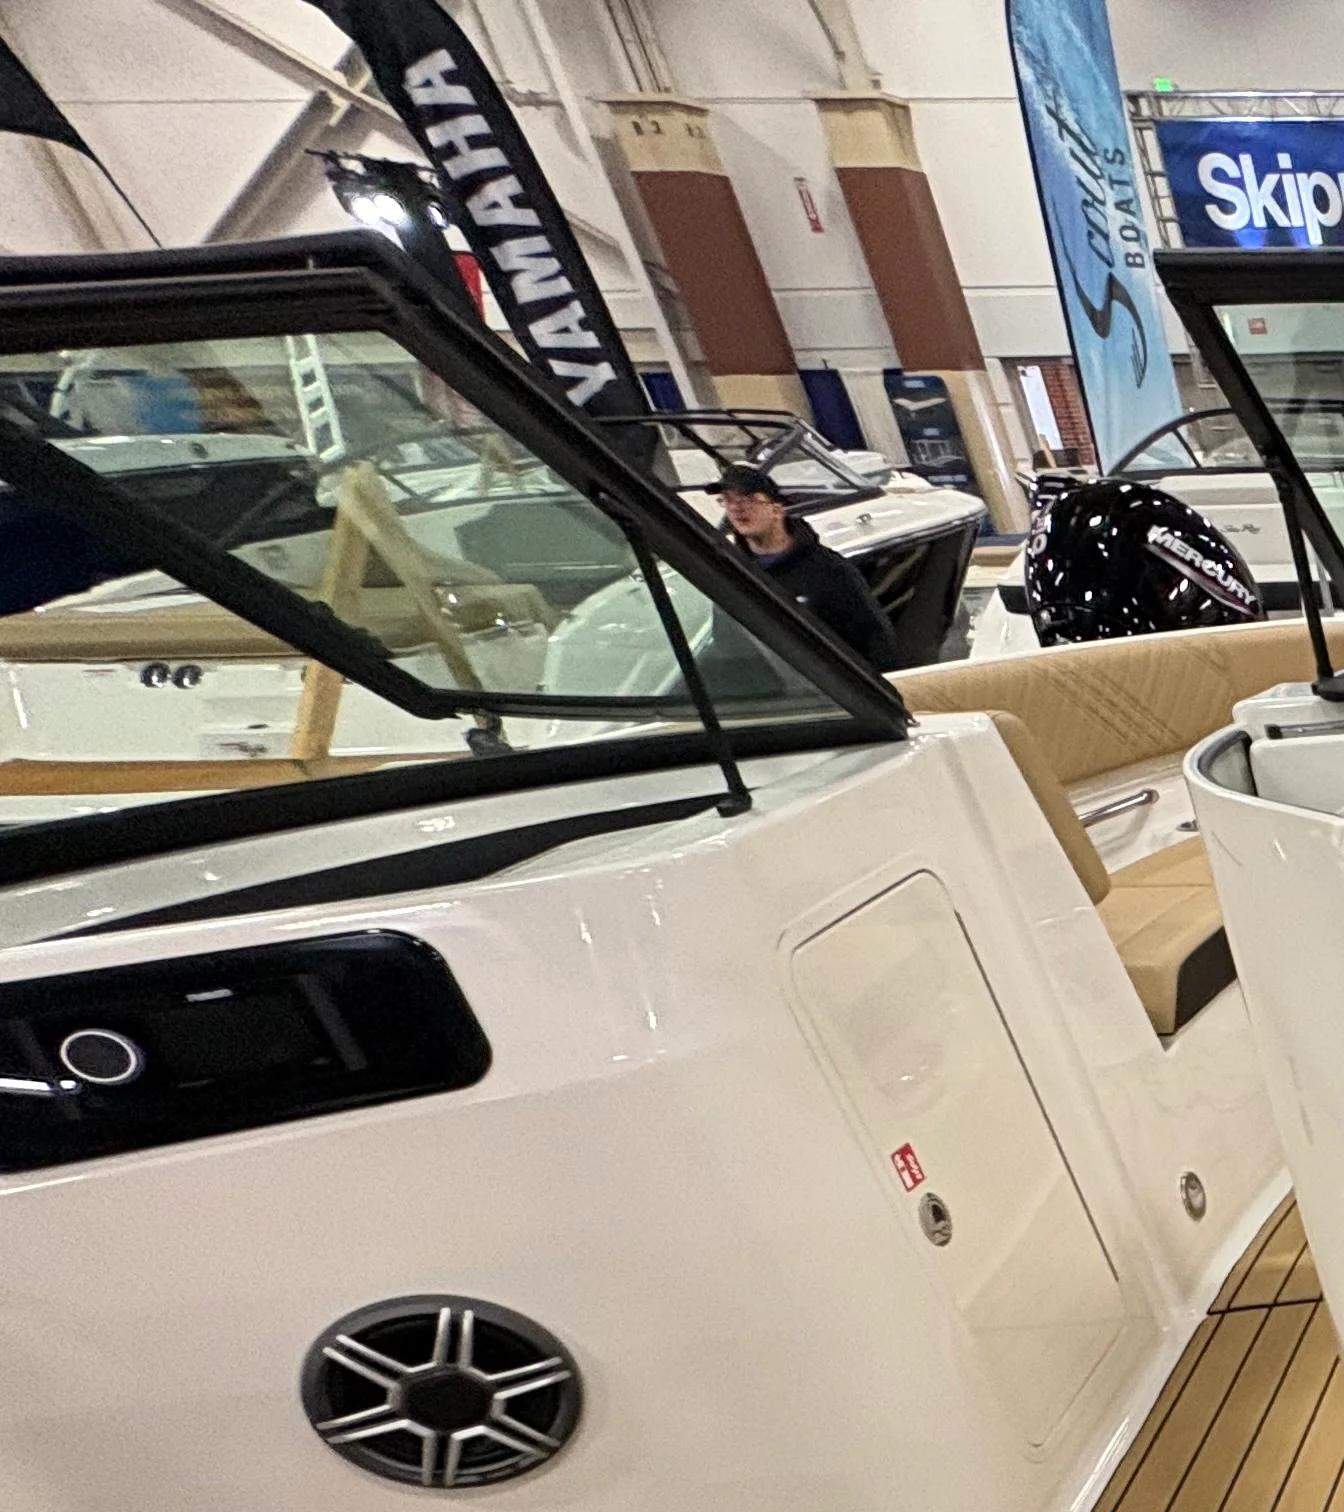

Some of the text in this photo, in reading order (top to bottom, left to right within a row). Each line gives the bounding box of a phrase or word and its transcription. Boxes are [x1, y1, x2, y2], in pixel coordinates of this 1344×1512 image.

[404, 47, 618, 405] YAMAHA
[1103, 147, 1146, 269] BOATS
[1147, 524, 1257, 604] MERCURY
